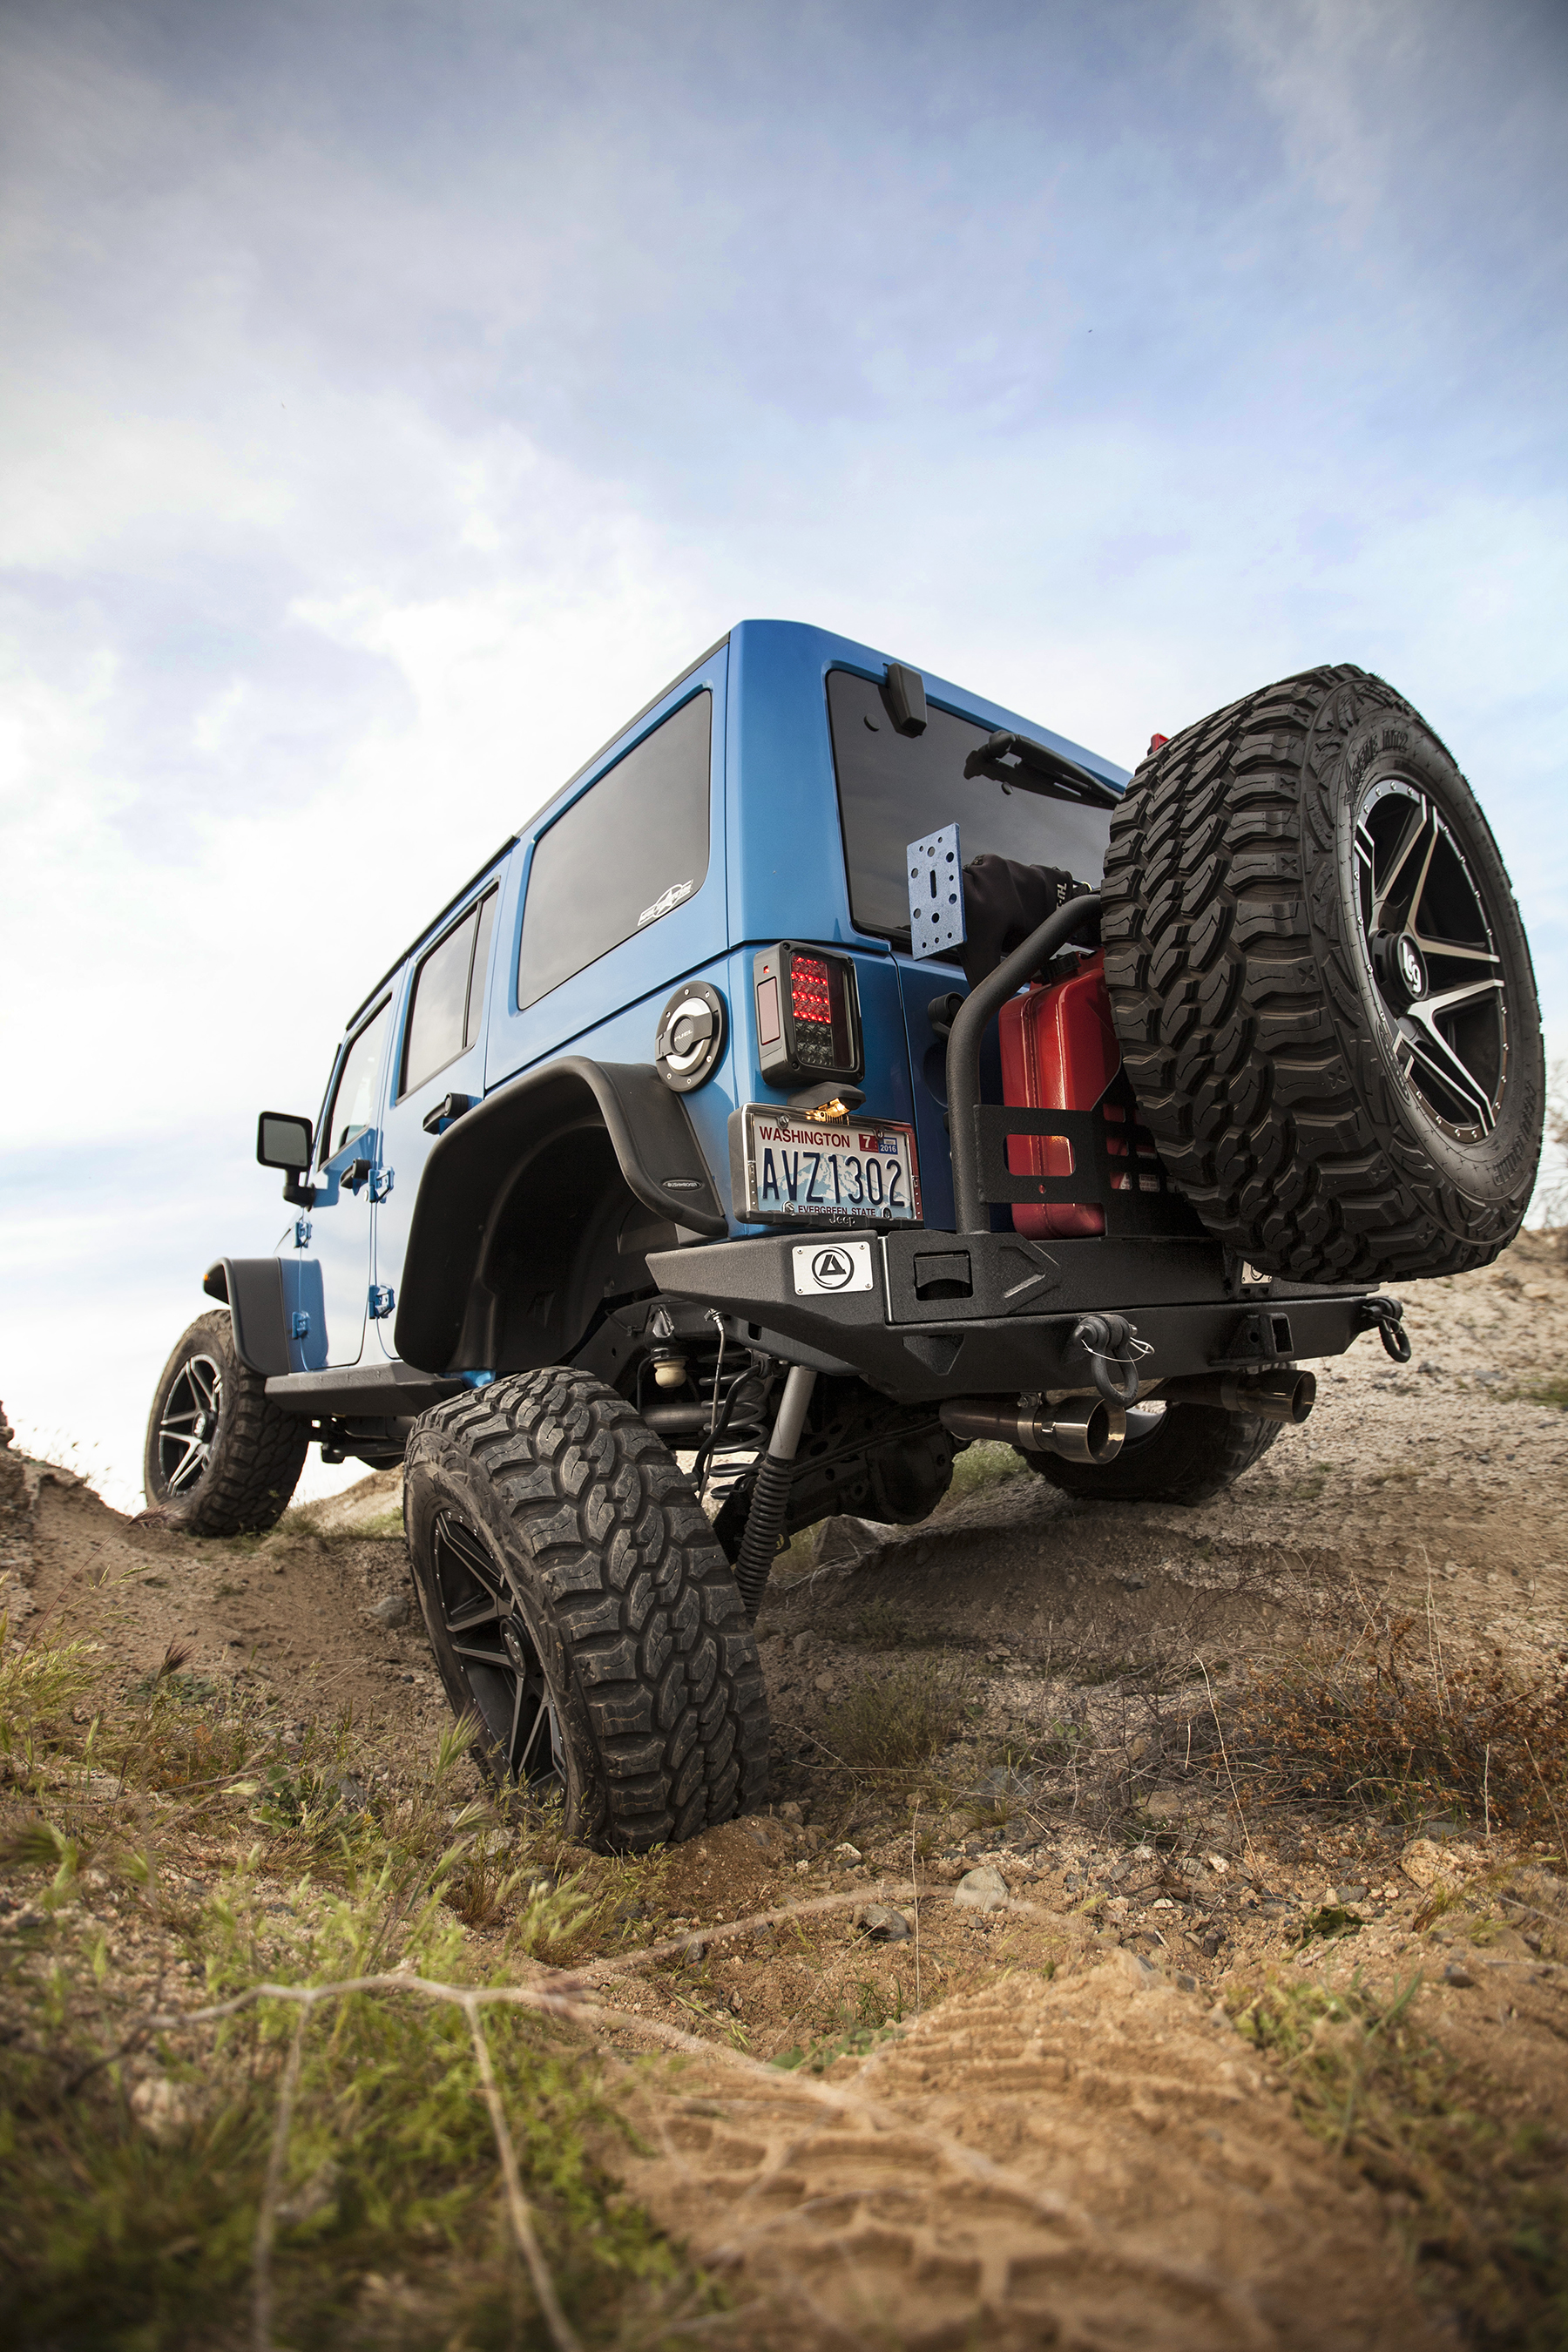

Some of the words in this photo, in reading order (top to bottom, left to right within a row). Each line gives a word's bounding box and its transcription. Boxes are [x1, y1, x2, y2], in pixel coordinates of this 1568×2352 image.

[673, 1029, 693, 1043] FUEL
[759, 1125, 851, 1149] WASHINGTON
[862, 1135, 871, 1149] 7
[880, 1145, 897, 1153] 2016
[761, 1147, 905, 1207] AVZ1302
[798, 1205, 848, 1215] EVERGREEN
[851, 1207, 876, 1217] STATE
[828, 1213, 856, 1227] Jeep
